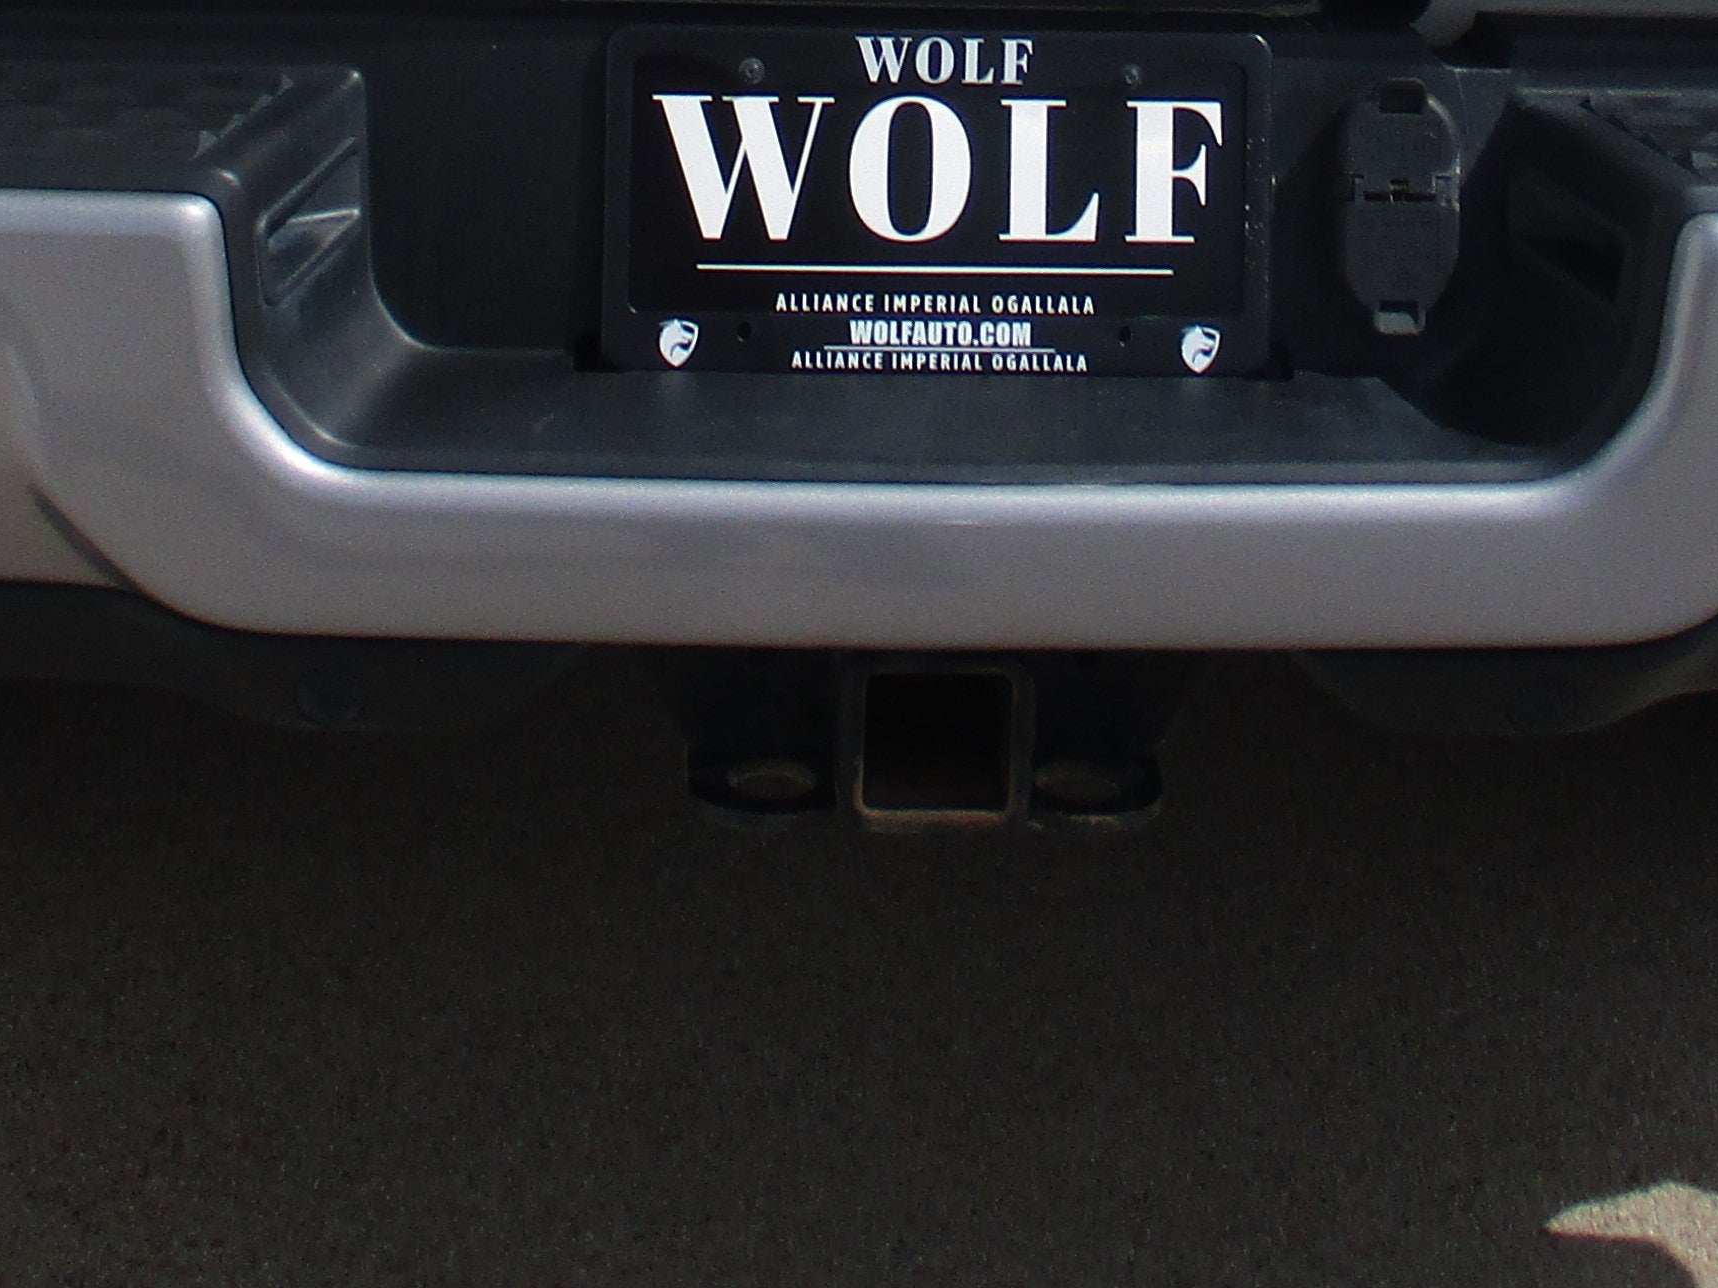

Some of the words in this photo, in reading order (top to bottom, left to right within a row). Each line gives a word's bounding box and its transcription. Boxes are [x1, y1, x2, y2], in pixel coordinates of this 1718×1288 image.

[855, 35, 1035, 86] WOLF
[651, 93, 1224, 244] WOLF
[775, 292, 875, 313] ALLIANCE
[884, 294, 982, 314] IMPERIAL
[991, 295, 1095, 315] OGALLALA
[849, 319, 1032, 347] WOLFAUTO.COM
[791, 350, 883, 371] ALLIANCE
[892, 352, 983, 372] IMPERIAL
[991, 353, 1088, 373] OGALLALA
